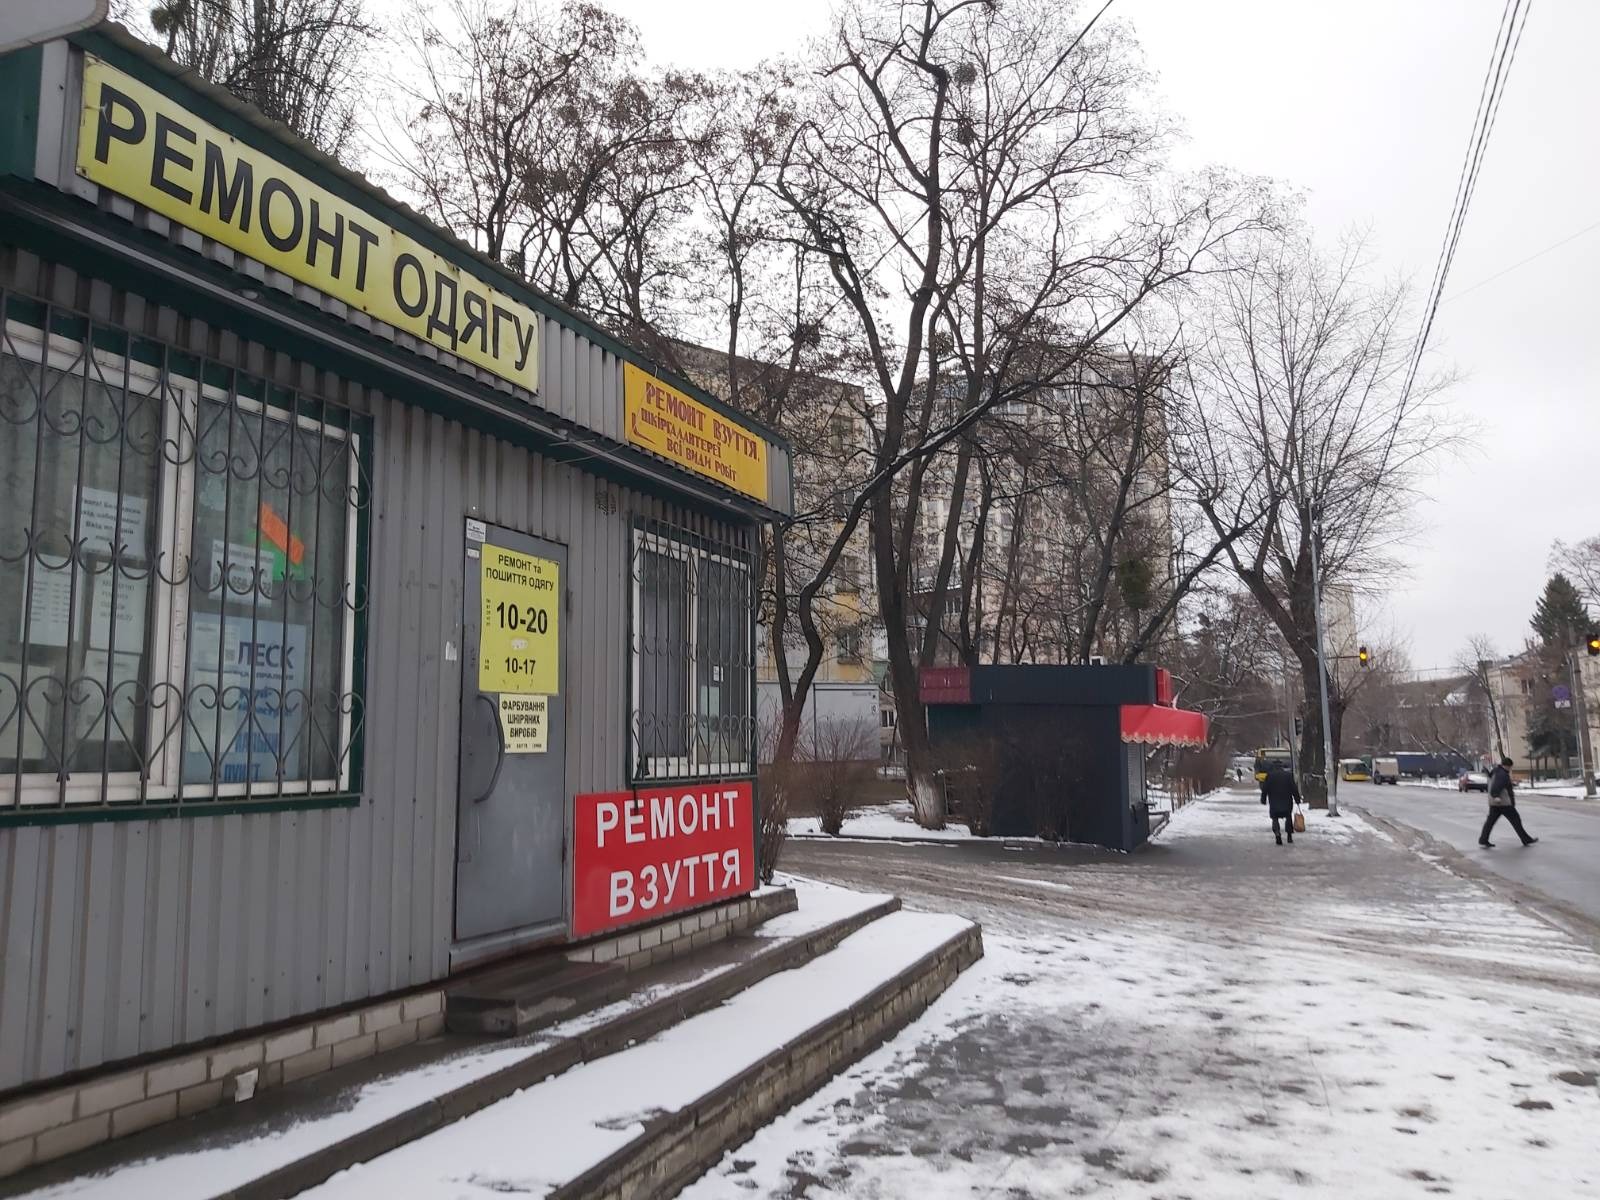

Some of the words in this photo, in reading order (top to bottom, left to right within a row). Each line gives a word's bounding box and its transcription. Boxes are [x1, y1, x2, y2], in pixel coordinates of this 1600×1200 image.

[95, 83, 379, 293] РЕМОНТ
[393, 253, 534, 372] ОДЯГУ
[645, 380, 706, 432] РЕМОНТ
[686, 447, 711, 470] ВИДИ
[498, 554, 532, 572] РЕМОНТ
[534, 565, 542, 574] та
[486, 567, 527, 587] ПОШИТТЯ
[529, 577, 554, 591] ОДЯГУ
[496, 601, 548, 635] 10-20
[505, 656, 536, 676] 10-17
[501, 700, 545, 712] ФАРБУВАННЯ
[510, 727, 537, 738] ВИРОБІВ
[596, 790, 739, 848] РЕМОНТ
[609, 848, 741, 918] ВЗУТТЯ
